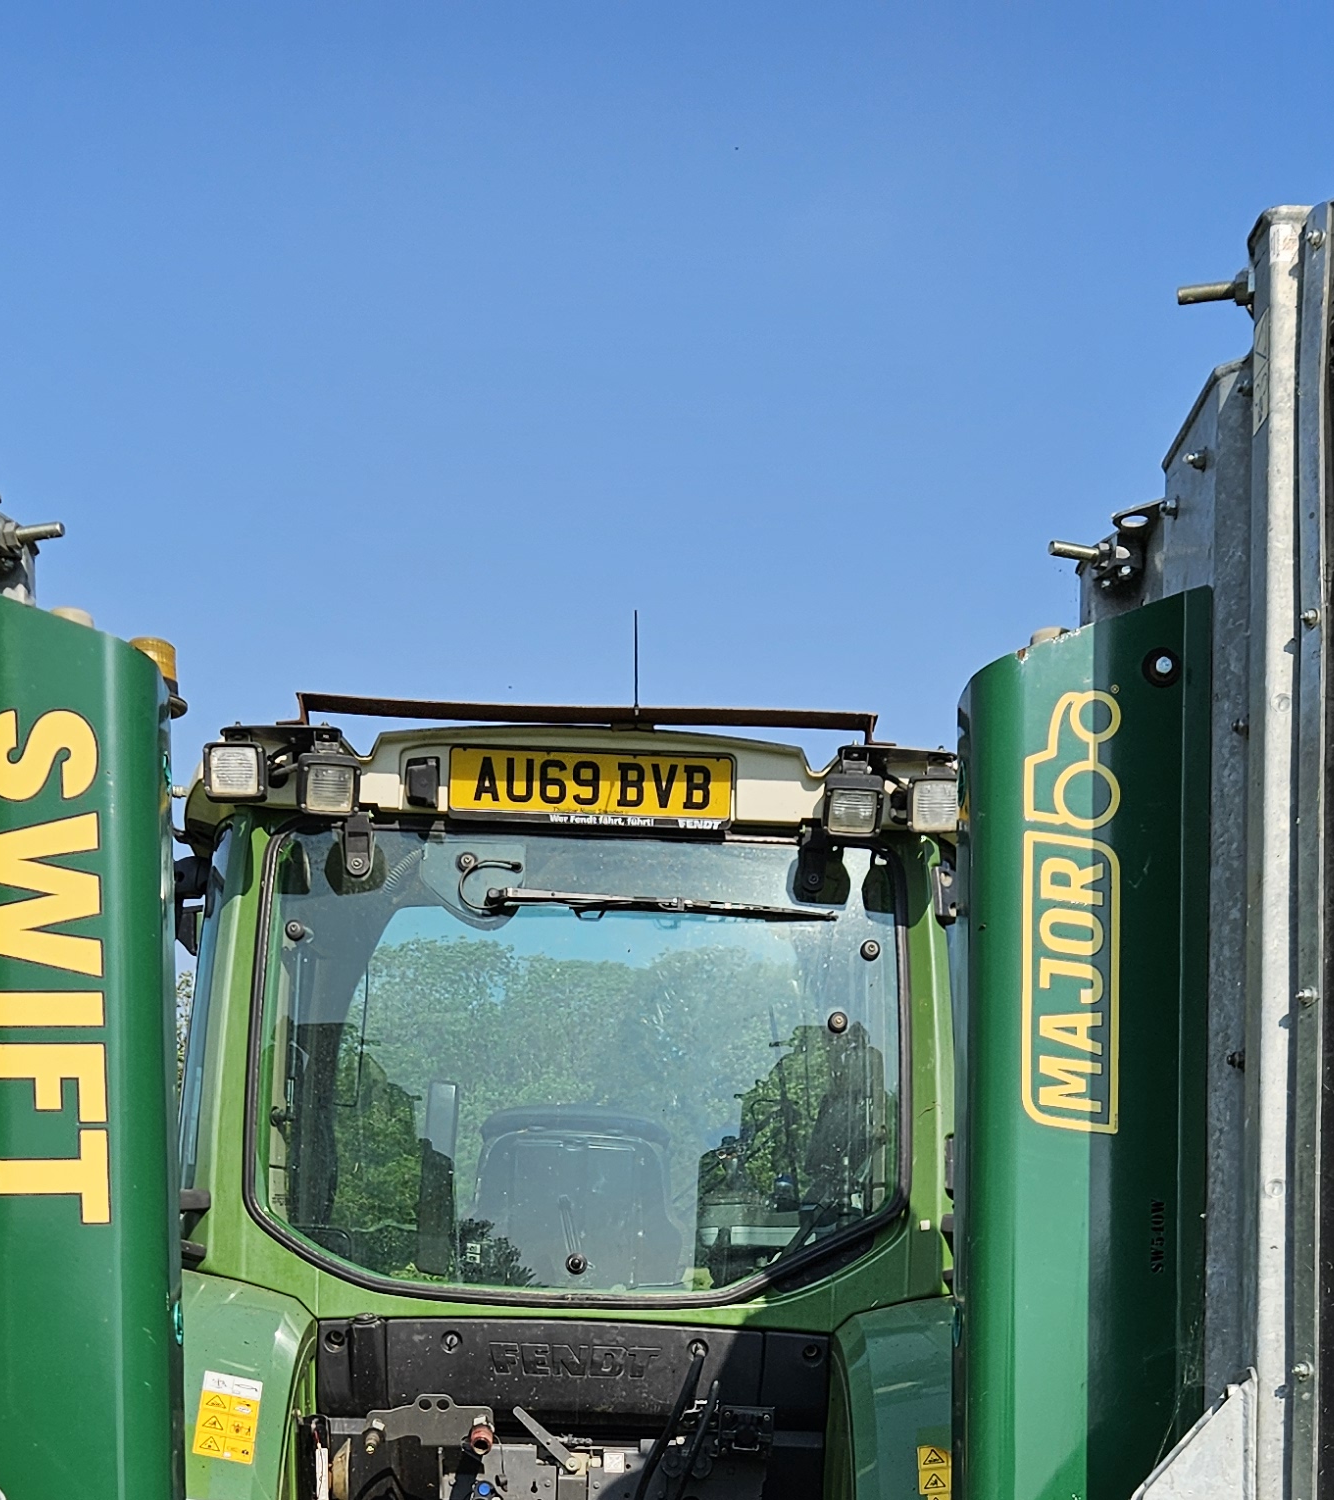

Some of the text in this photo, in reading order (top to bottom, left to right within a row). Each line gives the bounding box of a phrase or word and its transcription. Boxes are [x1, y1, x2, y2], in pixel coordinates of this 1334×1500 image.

[473, 756, 712, 811] AU69 BVB
[549, 814, 569, 823] Wer
[569, 814, 597, 825] Fendt
[678, 819, 722, 830] FENDT
[1038, 855, 1105, 1113] MAJOR
[489, 1341, 662, 1380] FENDT
